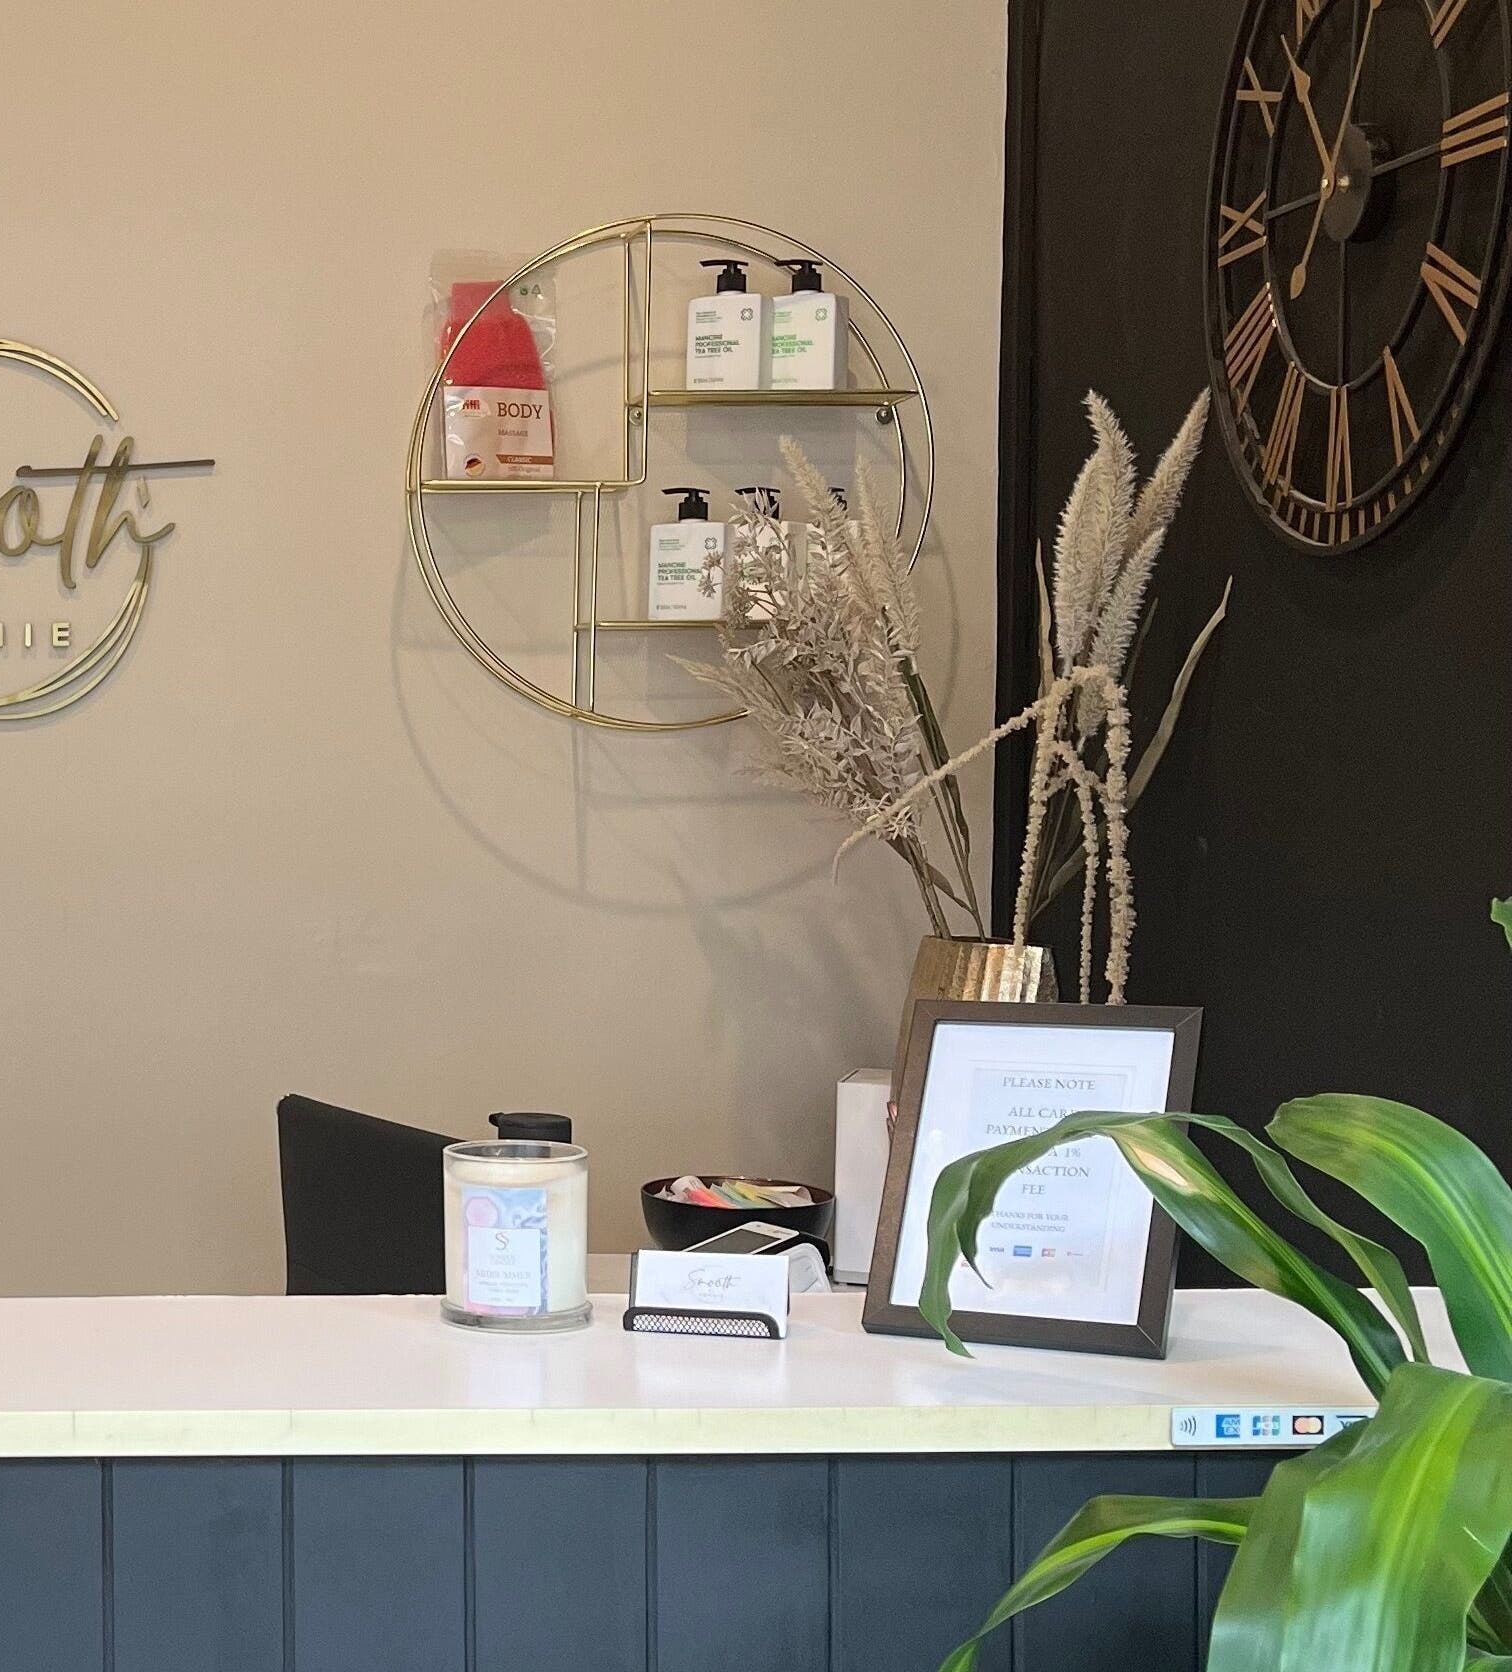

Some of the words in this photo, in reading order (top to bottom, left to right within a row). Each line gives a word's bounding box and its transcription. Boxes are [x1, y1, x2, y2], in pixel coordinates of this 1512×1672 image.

[496, 401, 543, 420] BODY
[1002, 1076, 1052, 1089] PLEASE
[1054, 1079, 1096, 1090] NOTE
[1008, 1106, 1035, 1118] ALL
[986, 1124, 1046, 1136] PAYMEN
[1021, 1183, 1045, 1195] FEE
